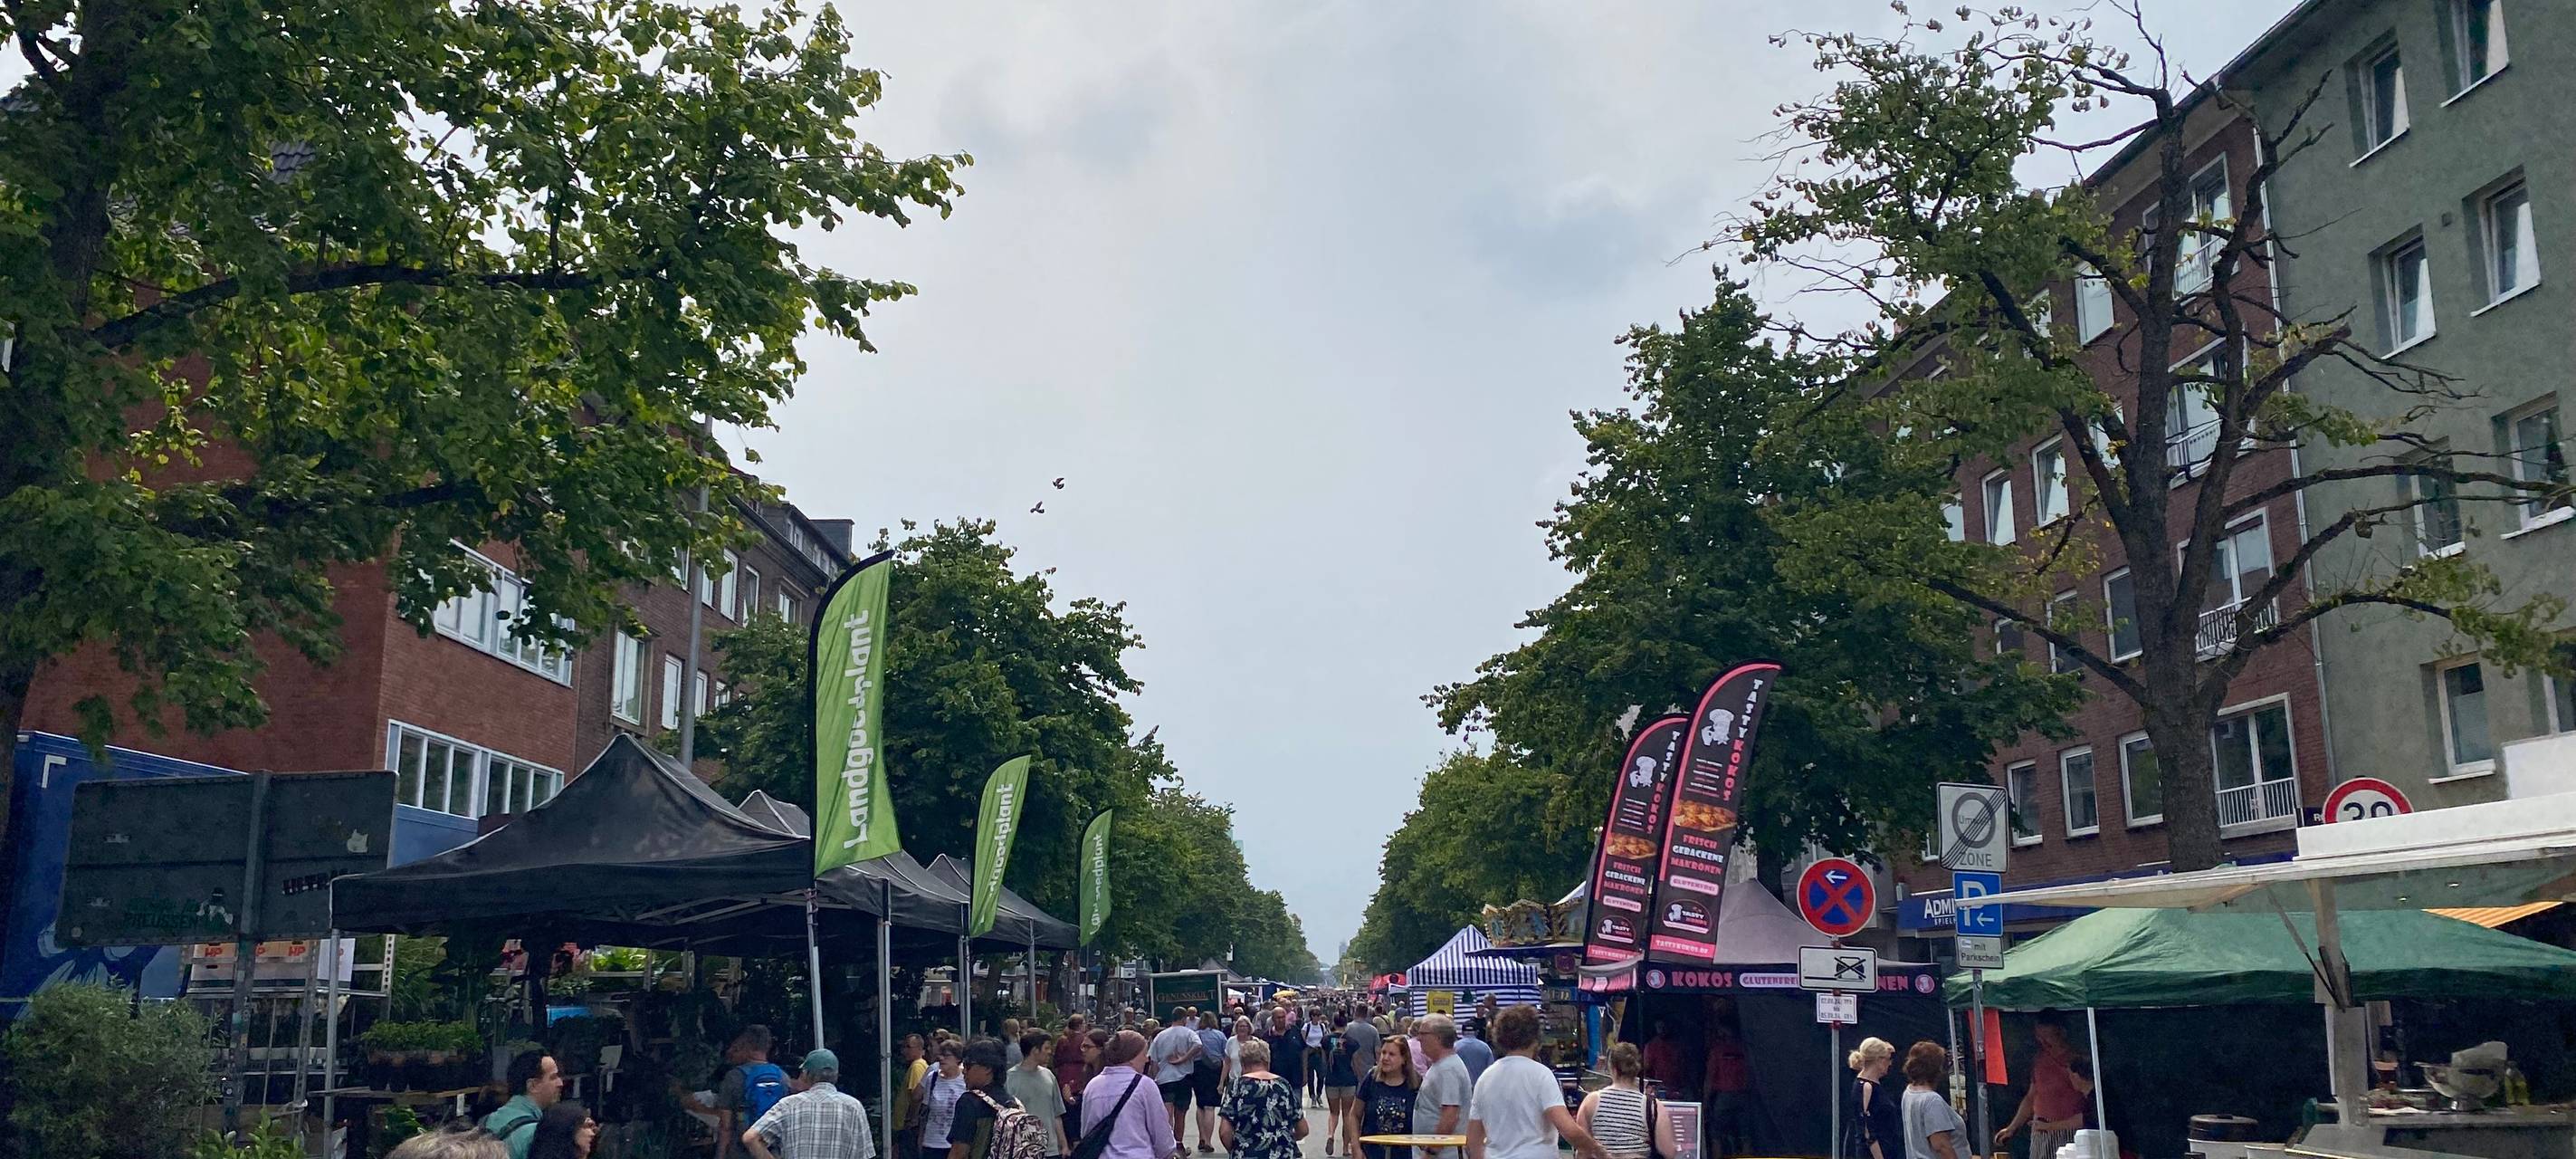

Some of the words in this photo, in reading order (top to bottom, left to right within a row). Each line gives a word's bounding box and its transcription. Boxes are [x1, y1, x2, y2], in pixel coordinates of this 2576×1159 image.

[1738, 679, 1763, 739] TASTY
[1660, 730, 1681, 782] TASTY
[1723, 739, 1745, 801] KOKOS
[1682, 834, 1717, 849] FRISCH
[1672, 845, 1724, 863] GEBACKENE
[1960, 852, 1993, 867] ZONE
[1669, 857, 1722, 875] MAKRONEN
[1605, 870, 1646, 886] GEBACKENE
[1682, 909, 1704, 919] TASTY
[1924, 897, 1955, 919] ADMI
[205, 946, 223, 957] HP
[288, 946, 306, 956] HP
[1973, 943, 1987, 951] mit
[1961, 952, 2000, 963] Parkschein
[1671, 971, 1732, 988] KOKOS
[1878, 975, 1909, 991] NEN
